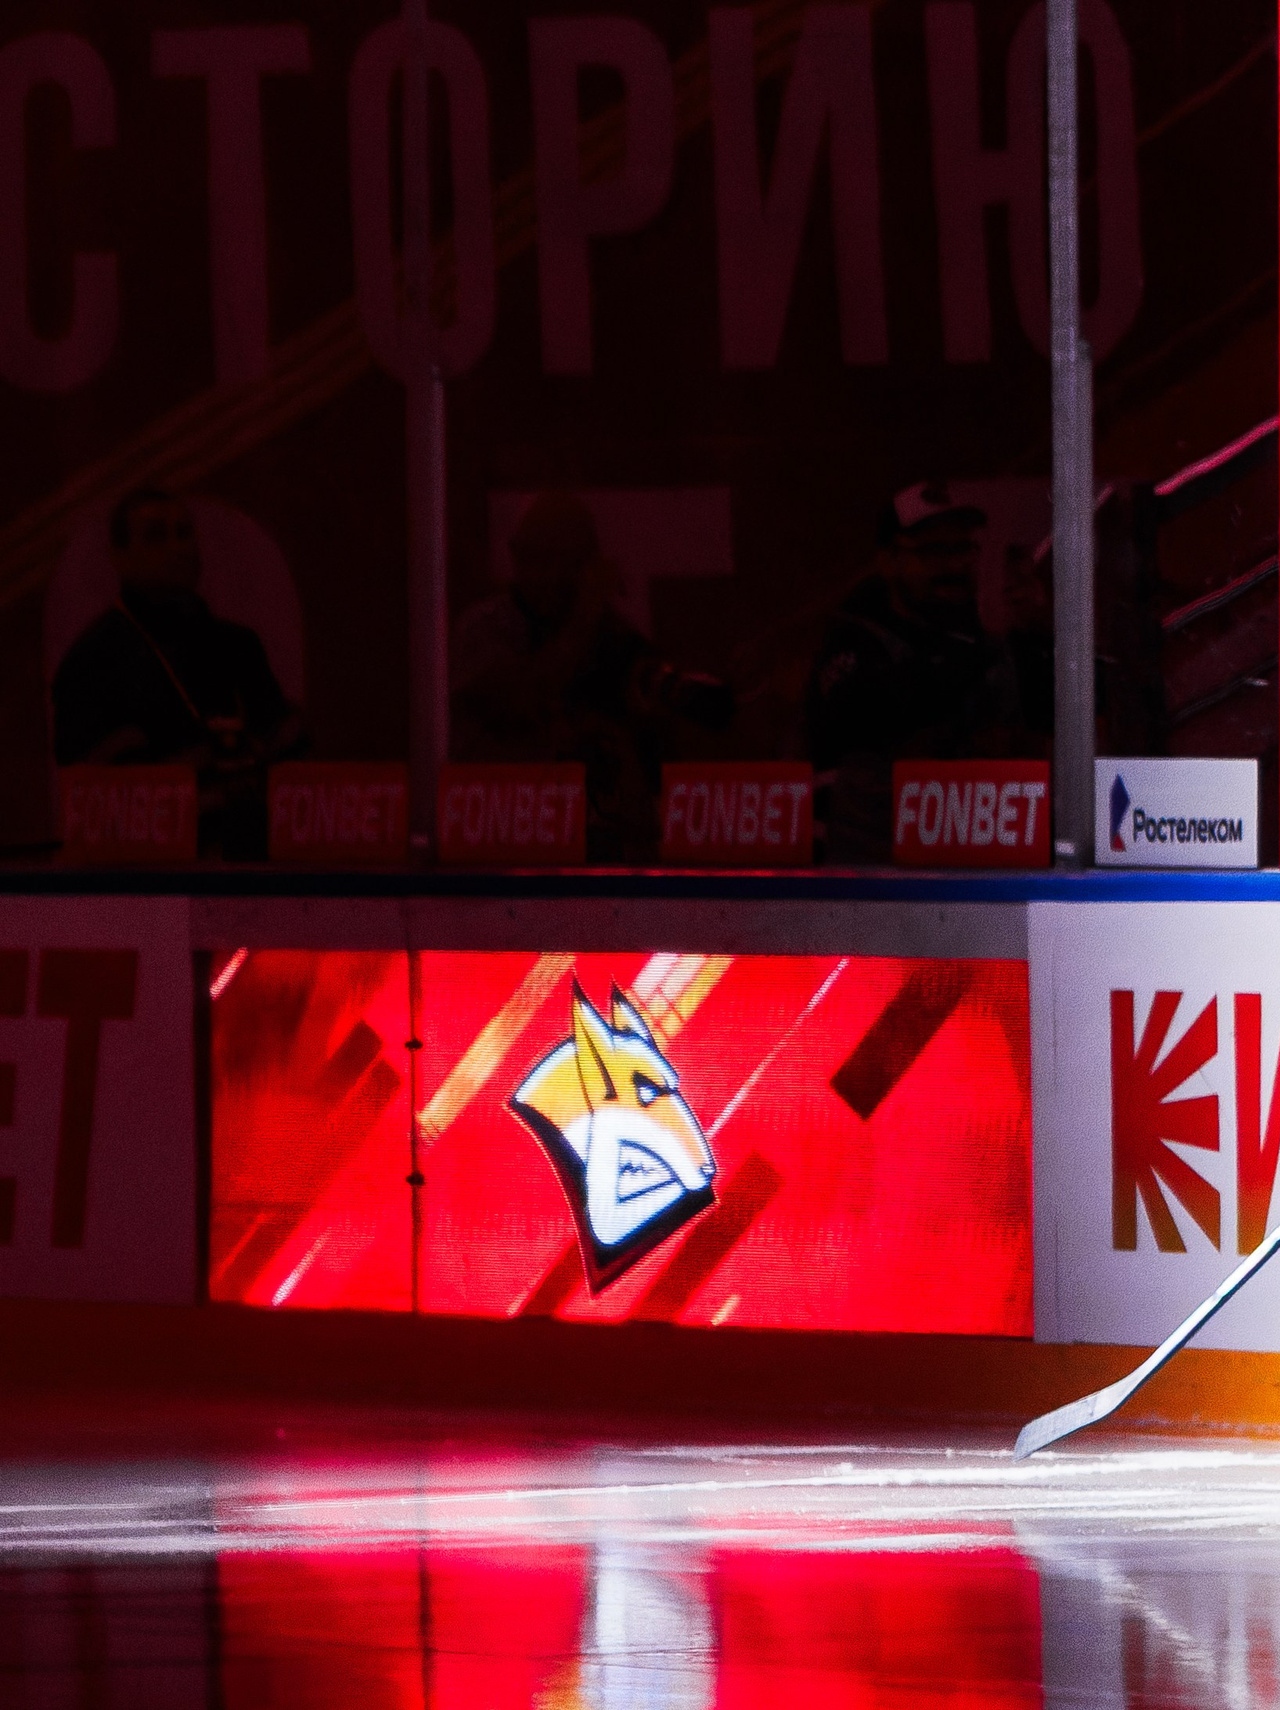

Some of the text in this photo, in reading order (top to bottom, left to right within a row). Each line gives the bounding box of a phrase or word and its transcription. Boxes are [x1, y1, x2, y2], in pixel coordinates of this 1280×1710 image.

[442, 784, 583, 842] FONBET
[664, 782, 810, 844] FONBET
[895, 781, 1046, 846] FONBET
[1132, 809, 1242, 845] Ростелеком
